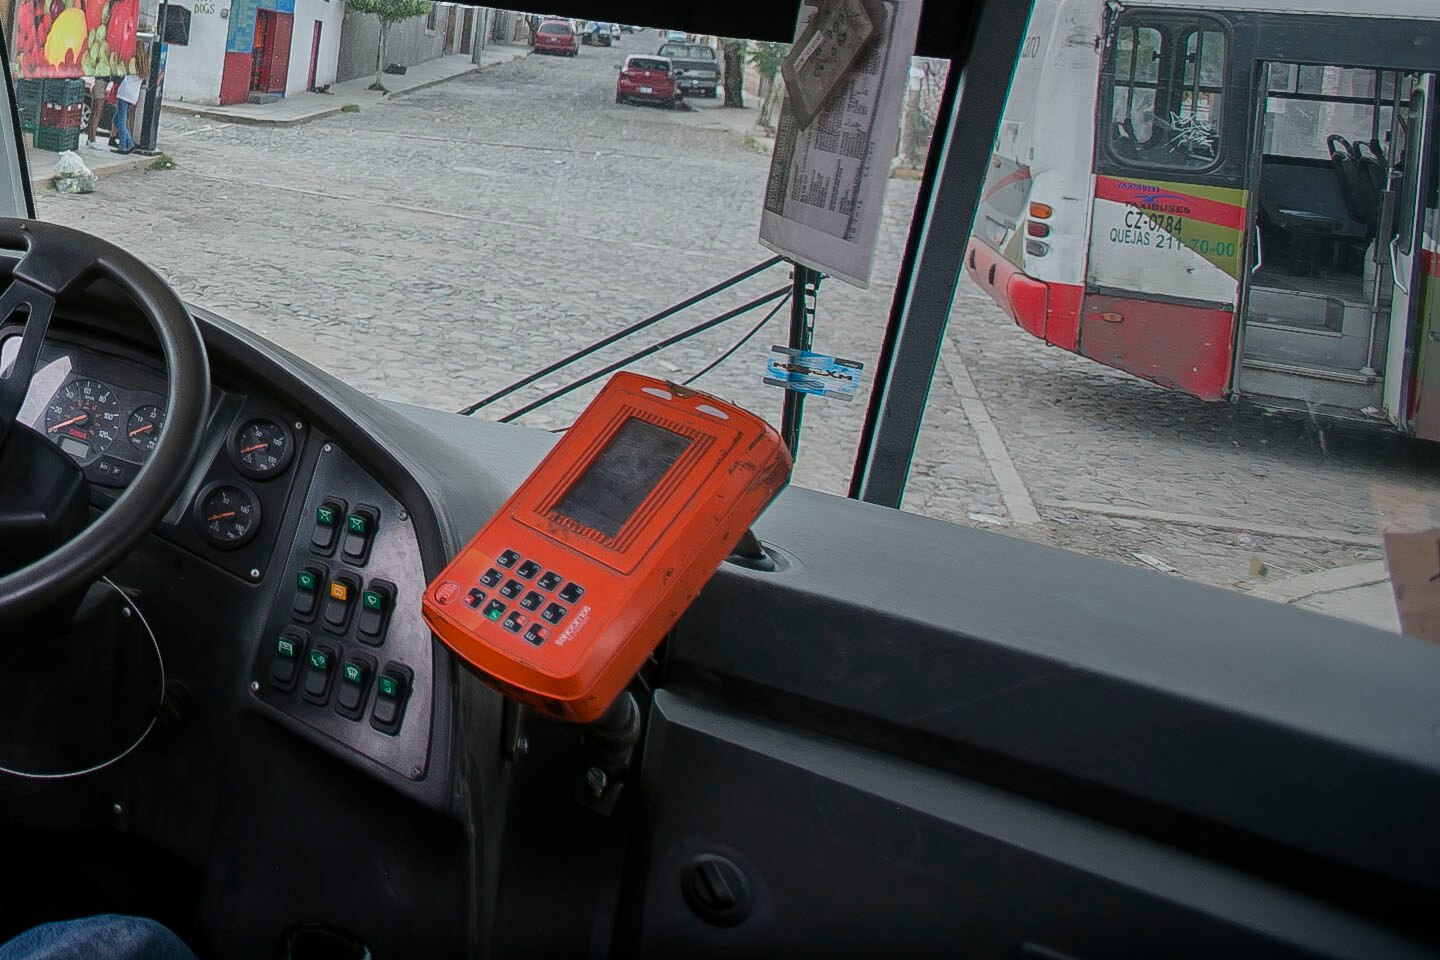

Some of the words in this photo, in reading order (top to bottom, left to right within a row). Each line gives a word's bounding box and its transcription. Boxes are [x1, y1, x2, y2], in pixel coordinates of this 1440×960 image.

[194, 3, 215, 14] DOGS
[1124, 210, 1183, 235] CZ-0784
[1110, 227, 1151, 246] QUEJAS
[1155, 234, 1236, 258] 211-70-00
[83, 387, 92, 395] 60
[98, 395, 107, 403] 80
[98, 430, 109, 439] 120
[521, 599, 532, 607] 5
[542, 611, 554, 619] 2
[524, 632, 535, 641] 3
